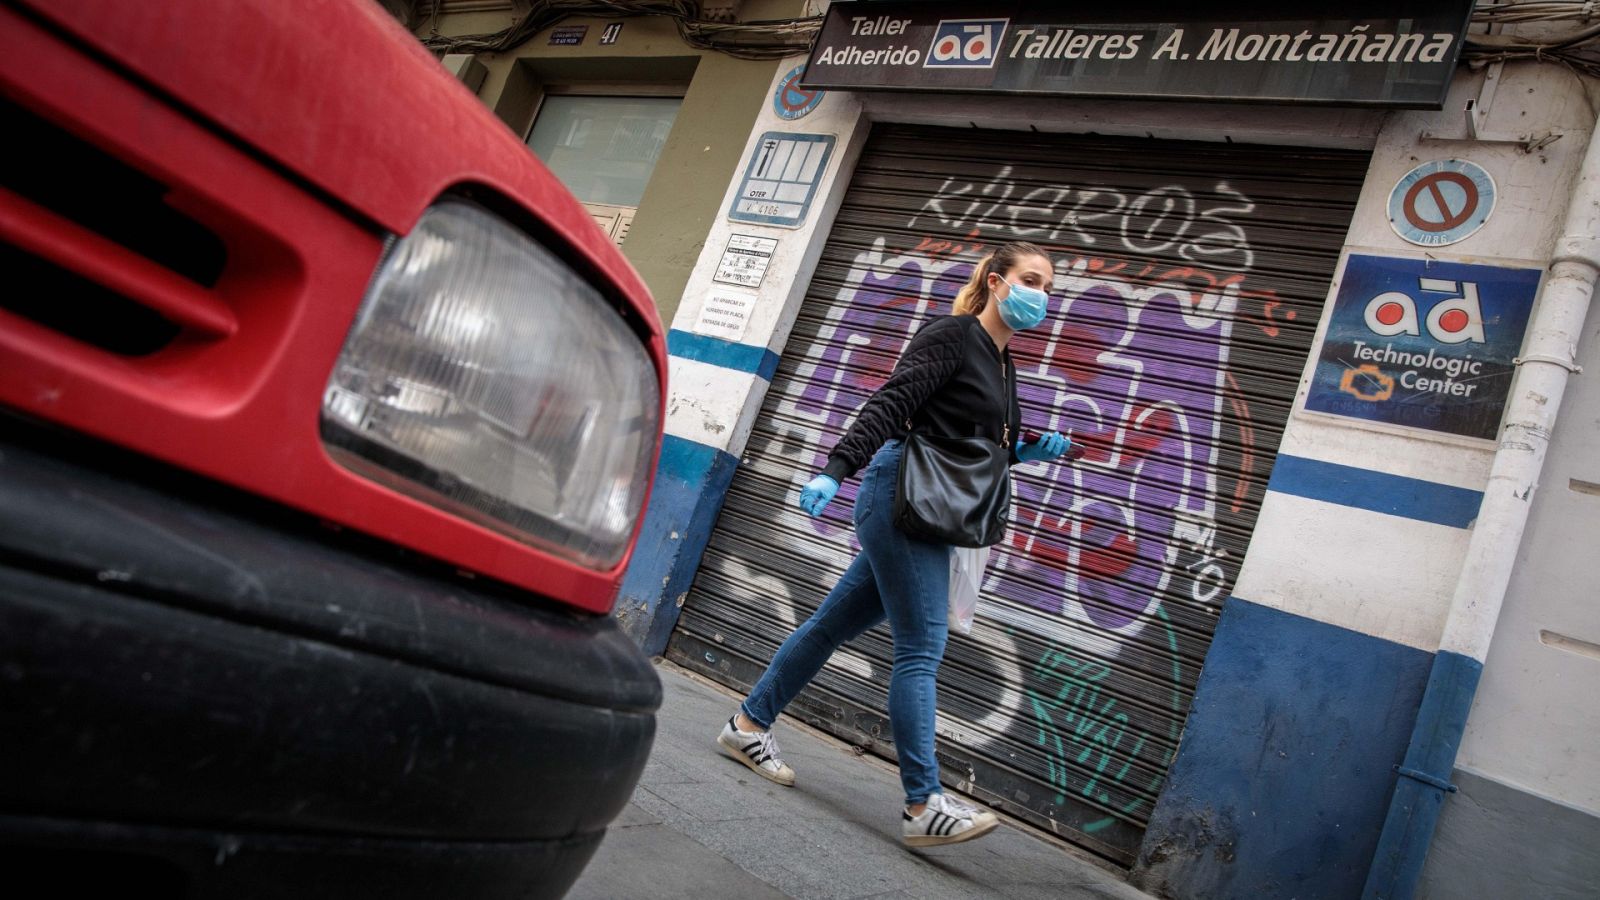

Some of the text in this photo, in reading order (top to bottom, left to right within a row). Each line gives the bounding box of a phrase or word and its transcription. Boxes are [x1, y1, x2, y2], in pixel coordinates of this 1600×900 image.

[601, 24, 621, 43] 41
[850, 16, 911, 36] Taller
[816, 45, 920, 65] Adherido
[933, 25, 992, 61] ad
[1009, 24, 1454, 63] Talleres A. Montañana
[1364, 277, 1487, 344] ad
[1353, 341, 1482, 377] Technologic
[1400, 370, 1477, 397] Center
